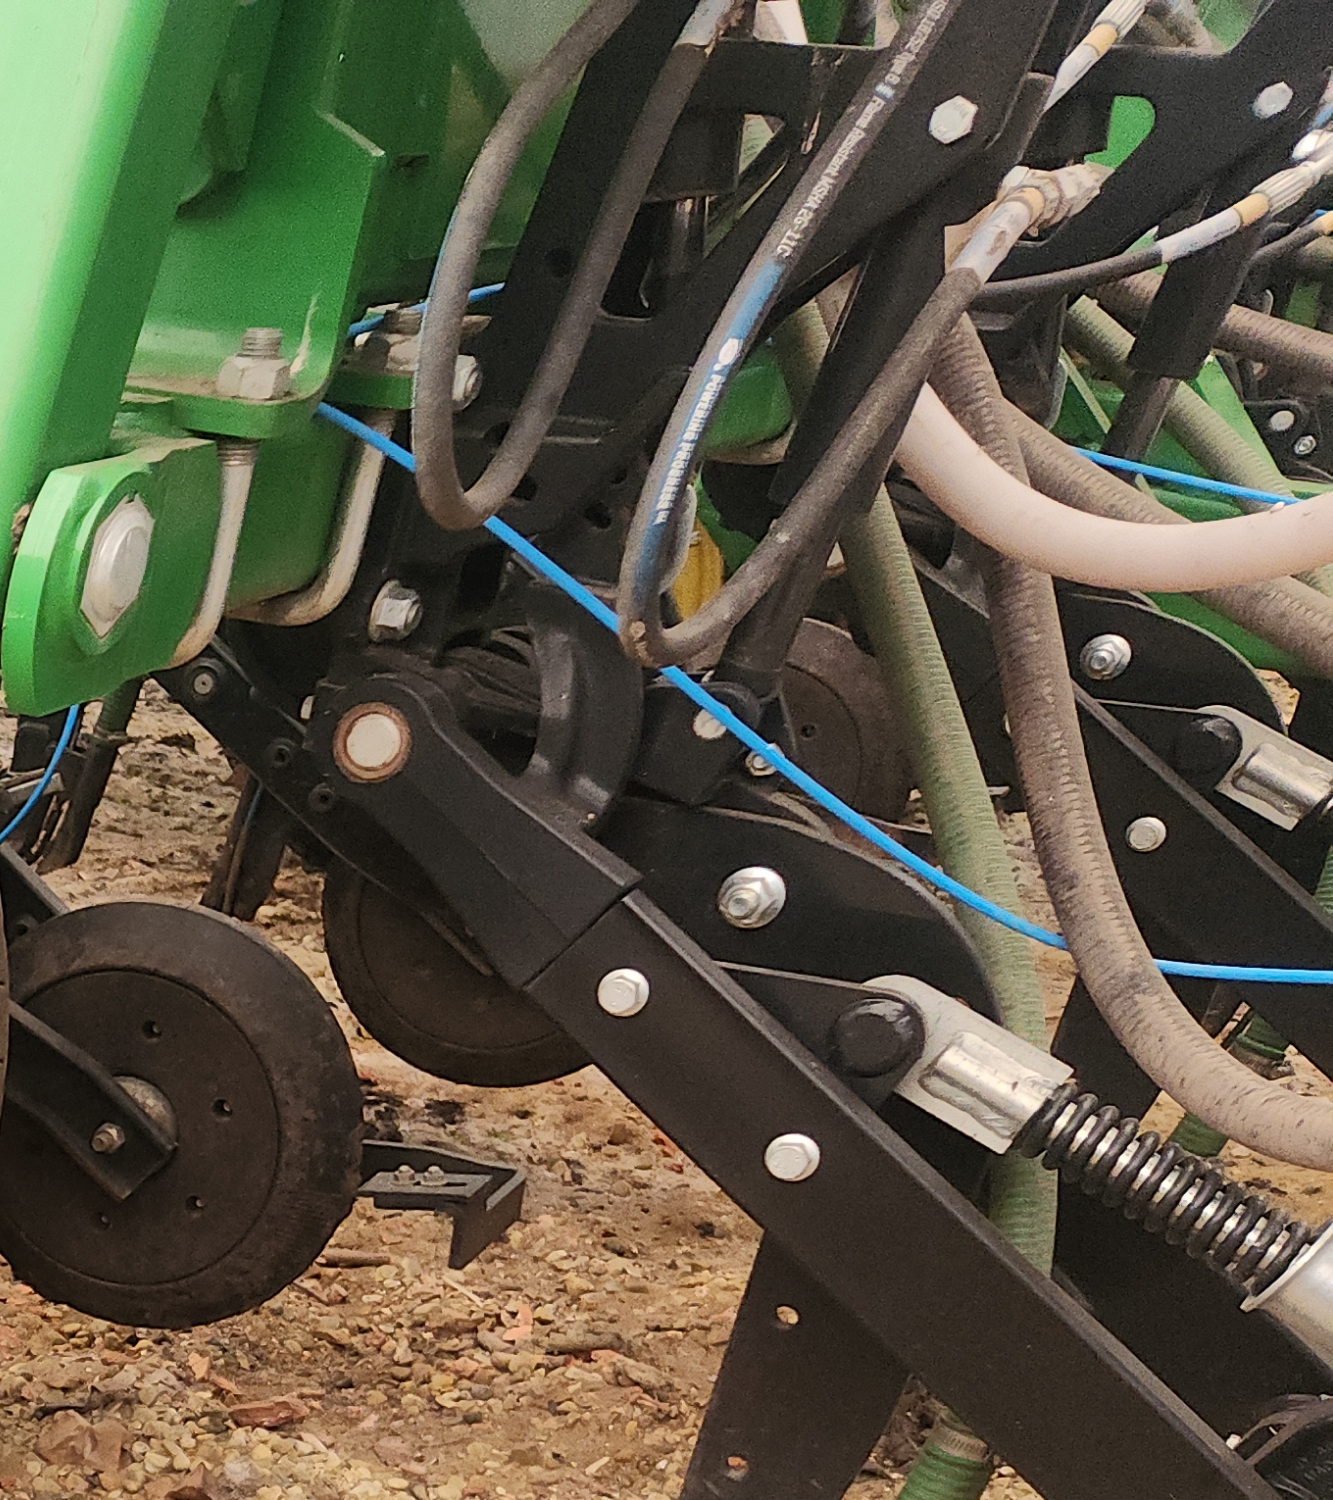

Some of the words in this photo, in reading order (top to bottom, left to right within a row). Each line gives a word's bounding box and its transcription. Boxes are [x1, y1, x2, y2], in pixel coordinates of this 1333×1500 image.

[855, 95, 886, 130] Flame
[829, 126, 866, 178] Resistant
[802, 174, 837, 214] MSHA
[682, 373, 726, 442] POWERING
